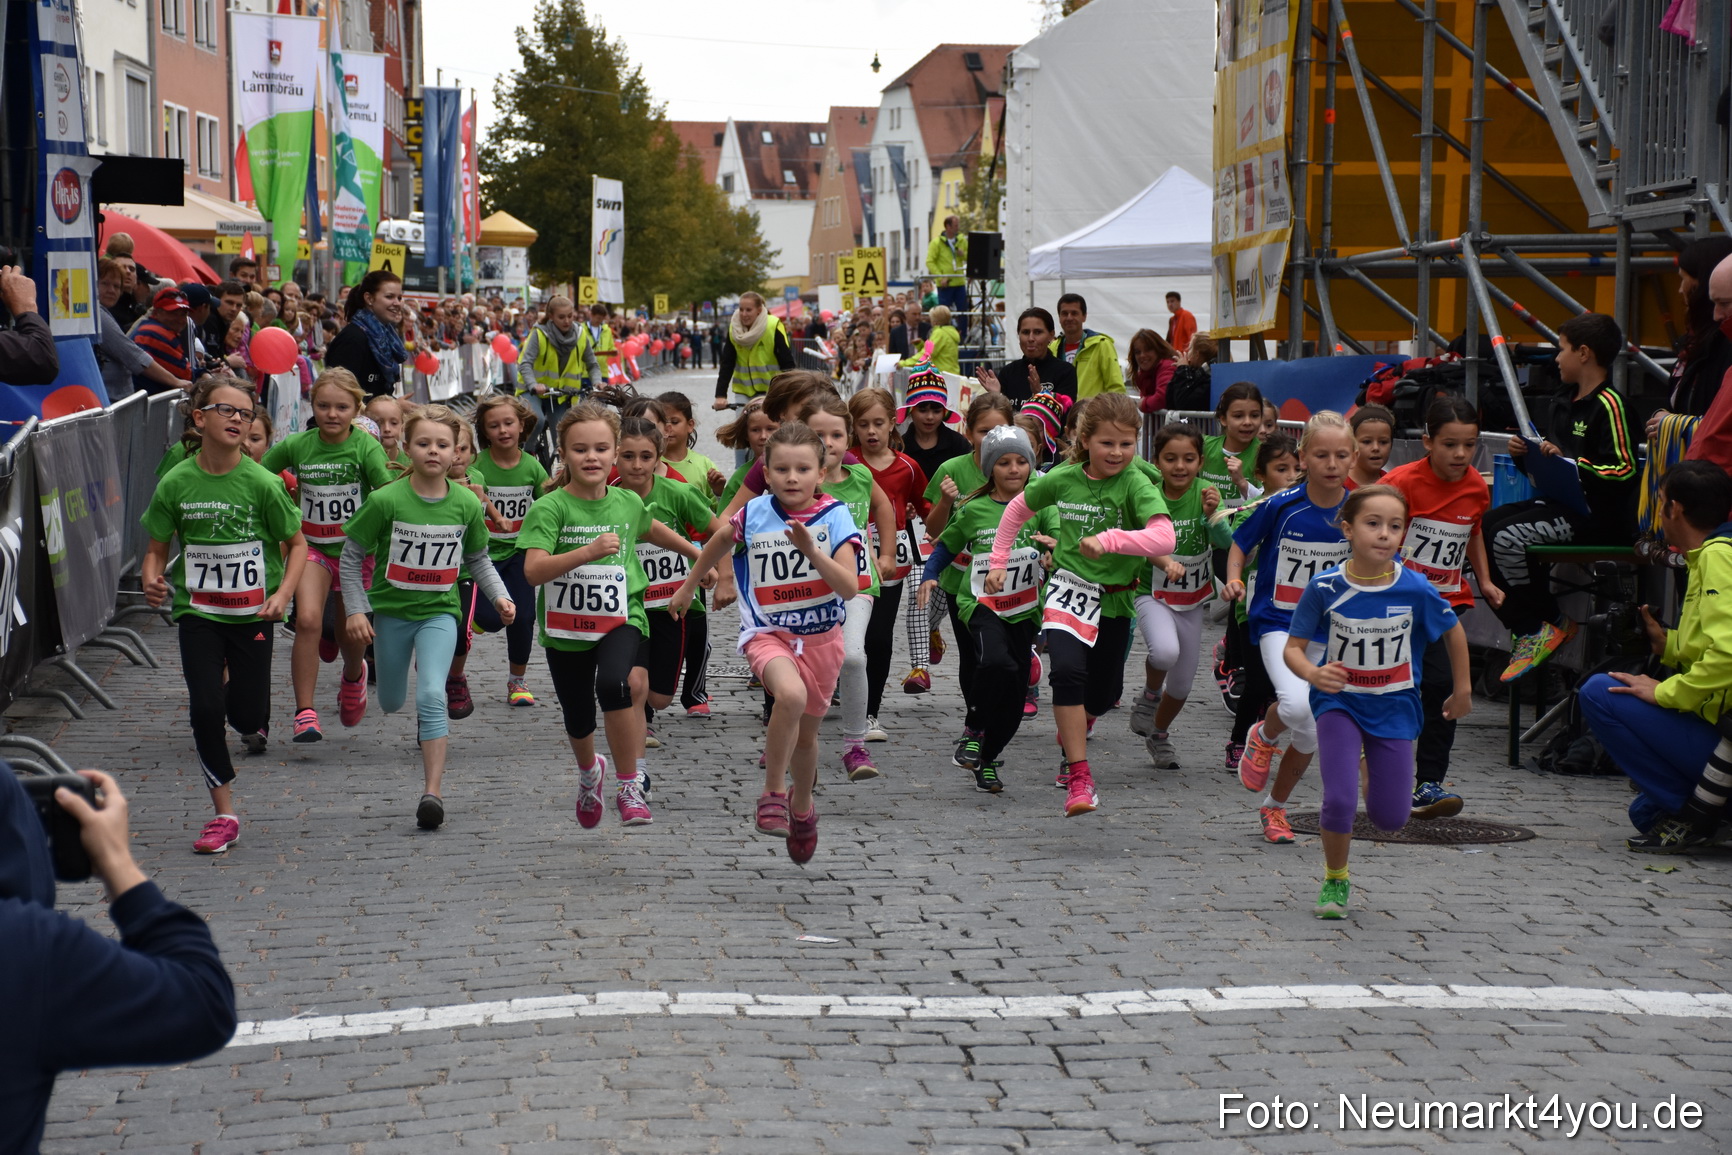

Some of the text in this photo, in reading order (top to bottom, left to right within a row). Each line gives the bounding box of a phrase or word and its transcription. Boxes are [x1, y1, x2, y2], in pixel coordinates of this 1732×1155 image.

[220, 224, 262, 233] Klostergasse
[375, 244, 402, 257] Block
[857, 250, 883, 259] Block
[844, 268, 854, 284] B
[862, 262, 880, 286] A
[583, 286, 593, 299] C
[300, 471, 334, 479] Stadtlauf
[181, 501, 230, 510] Neumarkter
[306, 498, 355, 522] 7199
[1057, 501, 1101, 512] Neumarkter
[561, 524, 610, 533] Neumarkter
[1172, 518, 1191, 526] rkter
[1412, 522, 1437, 535] PARTL
[322, 527, 336, 536] Lili
[394, 528, 419, 538] PARTL
[645, 547, 669, 556] Neum
[751, 541, 772, 550] ARTL
[1282, 545, 1346, 557] PARTL Neumarkt
[1413, 534, 1466, 566] 7138
[213, 551, 249, 559] Neumarkt
[399, 539, 458, 567] 7177
[643, 553, 686, 582] 084
[974, 559, 990, 567] PART
[1287, 557, 1348, 582] 71
[194, 560, 258, 589] 7176
[408, 571, 442, 582] Cecilia
[574, 572, 612, 580] Neumarkt
[978, 564, 1033, 593] 774
[645, 587, 674, 599] Emilia
[1069, 579, 1100, 594] Neumarkt
[209, 595, 250, 605] Johanna
[553, 581, 619, 612] 7053
[773, 586, 812, 601] Sophia
[1045, 583, 1101, 621] 7437
[574, 617, 596, 630] Lisa
[1332, 619, 1399, 634] PARTL Neumarkt
[1336, 633, 1404, 666] 7117
[1347, 672, 1391, 685] Simone
